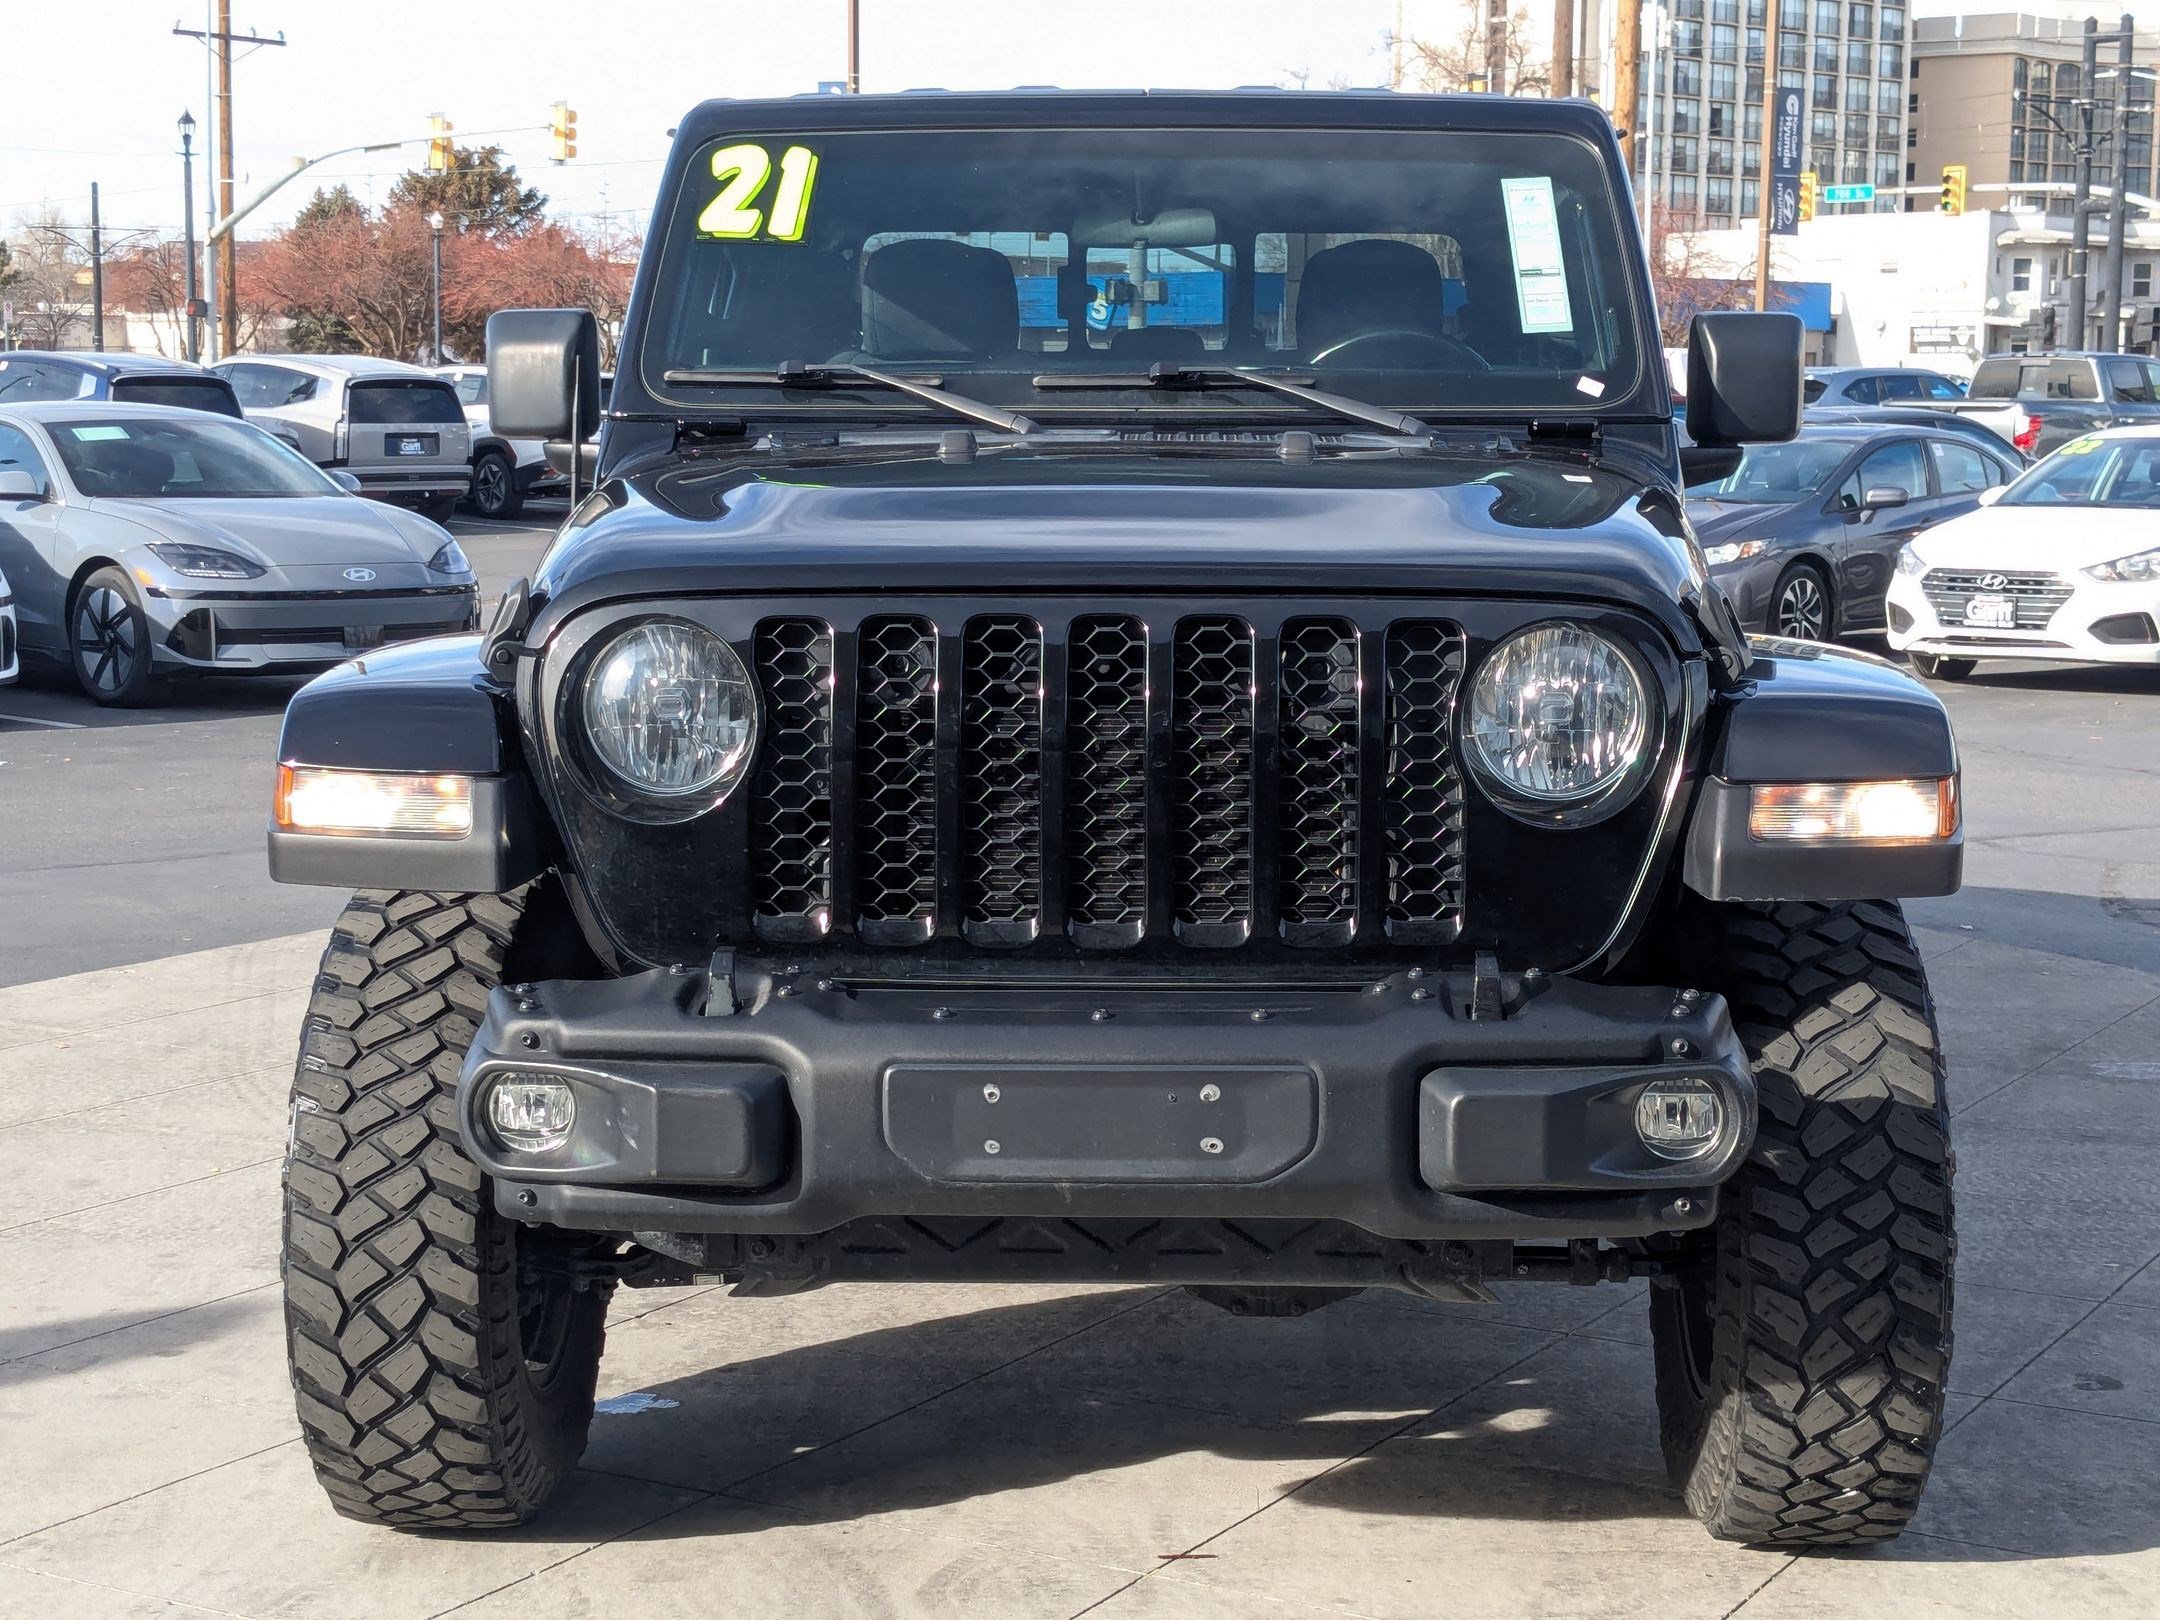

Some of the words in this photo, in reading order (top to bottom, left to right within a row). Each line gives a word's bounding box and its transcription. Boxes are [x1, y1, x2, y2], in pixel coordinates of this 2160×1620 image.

[1783, 116, 1791, 169] Hyundai
[698, 144, 819, 241] 21
[1776, 182, 1784, 230] HYUNDAI
